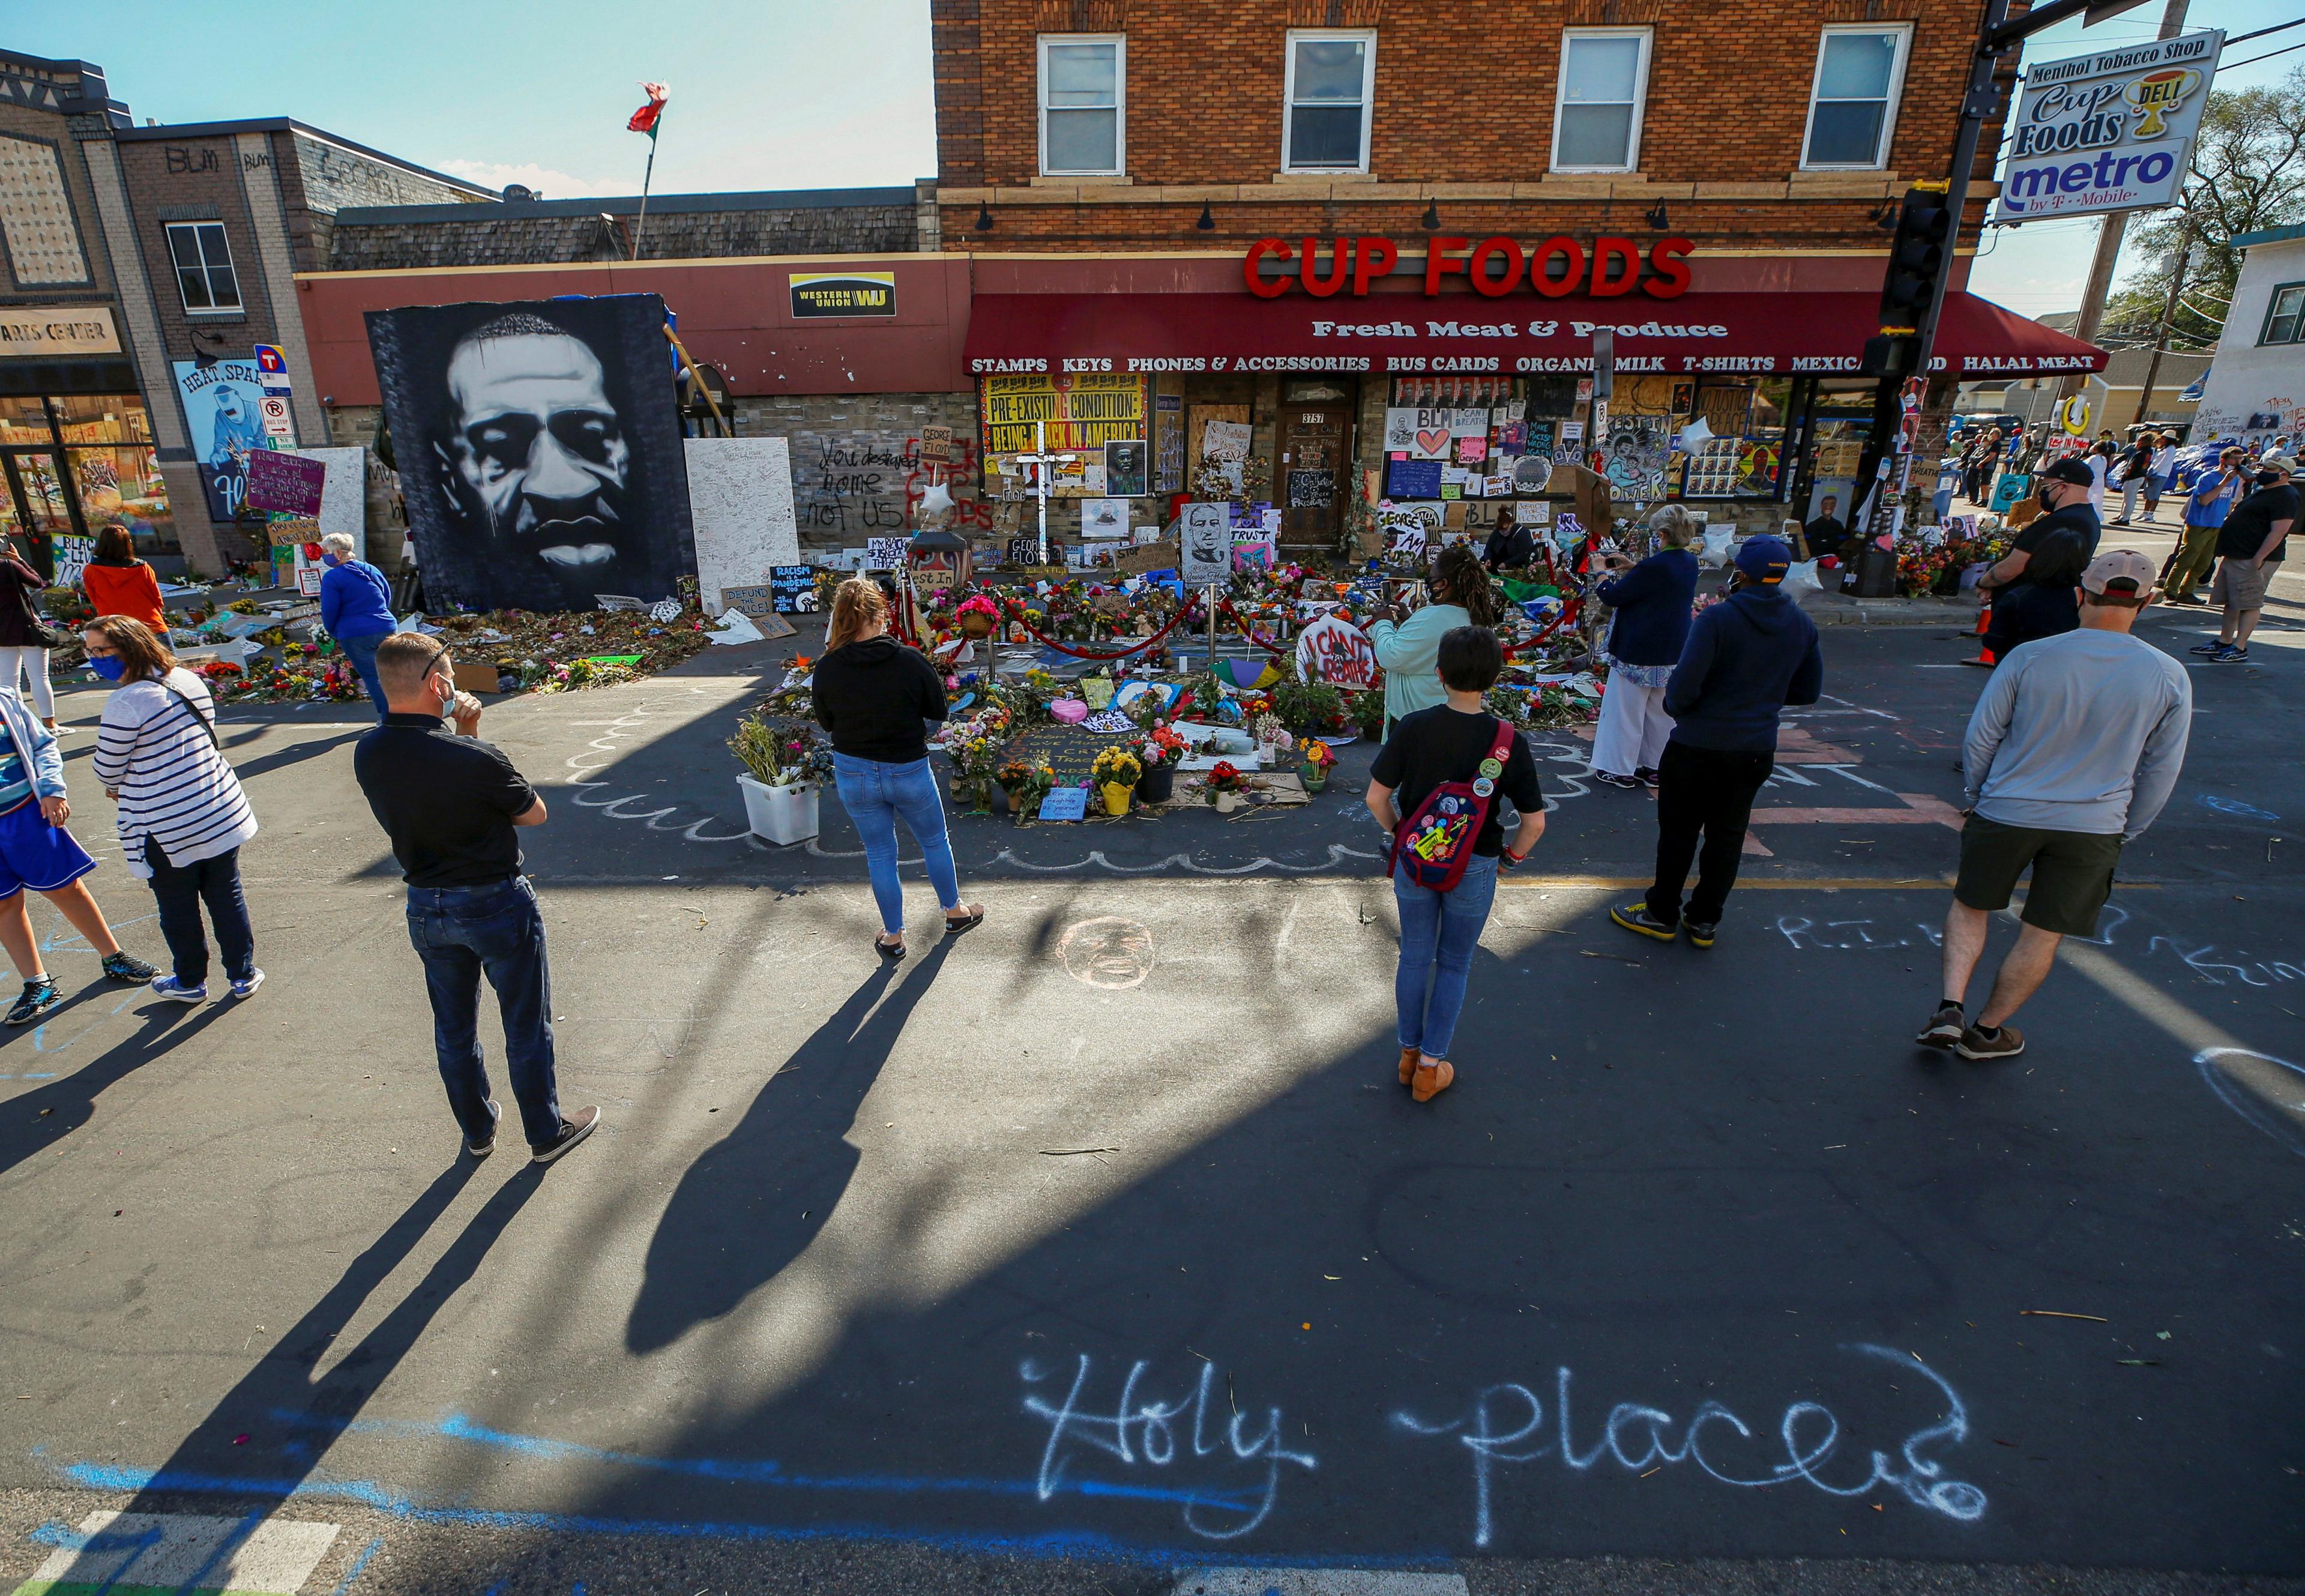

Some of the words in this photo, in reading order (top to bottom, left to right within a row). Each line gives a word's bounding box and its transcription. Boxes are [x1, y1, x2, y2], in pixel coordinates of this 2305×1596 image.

[2031, 58, 2090, 84] Menthol
[2096, 49, 2159, 72] Tobacco
[2164, 38, 2205, 60] Shop
[2138, 80, 2181, 106] DELI
[2031, 83, 2124, 122] Cup
[2013, 113, 2122, 156] Foods
[165, 146, 219, 174] BLM
[244, 153, 270, 172] BLM
[2008, 151, 2174, 200] metro
[2030, 199, 2047, 212] by
[1244, 236, 1398, 299] CUP
[1425, 236, 1696, 299] FOODS
[799, 291, 851, 300] WESTERN
[855, 289, 886, 307] WU
[1, 324, 42, 342] ARTS
[46, 322, 107, 341] CENTER
[1312, 321, 1417, 337] Fresh
[1426, 321, 1519, 337] Meat
[1528, 320, 1559, 337] &
[971, 358, 1047, 372] STAMPS
[1062, 358, 1113, 372] KEYS
[1127, 357, 1205, 372] PHONES
[1211, 357, 1228, 371] &
[1233, 357, 1370, 371] ACCESSORIES
[1387, 357, 1426, 371] BUS
[1431, 357, 1499, 371] CARDS
[1516, 357, 1594, 371] ORGANI
[1614, 357, 1665, 371] MILK
[1683, 357, 1776, 371] T-SHIRTS
[1791, 356, 1862, 370] MEXIC
[1963, 357, 2034, 370] HALAL
[2037, 355, 2094, 370] MEAT
[182, 366, 225, 394] HEAT,
[990, 394, 1068, 422] PRE-EXISTING
[1071, 393, 1137, 419] CONDITION:
[1712, 390, 1749, 412] JUSTICE
[1303, 414, 1324, 423] 3757
[1417, 409, 1453, 429] BLM
[1455, 409, 1460, 418] I
[1464, 409, 1486, 418] CANT
[1210, 423, 1220, 433] No
[1321, 423, 1343, 435] Child
[1455, 418, 1487, 427] BREATHE
[1531, 422, 1549, 432] MAKE
[1649, 416, 1674, 442] IN
[1711, 411, 1746, 436] PEACE
[923, 429, 950, 442] GEORGE
[992, 425, 1027, 452] BEING
[1031, 423, 1066, 450] BACK
[1070, 423, 1082, 449] IN
[1529, 432, 1553, 441] RACISM
[925, 444, 950, 456] FLOYD
[1528, 440, 1552, 449] WRONG
[819, 438, 858, 469] You
[1459, 453, 1481, 462] George
[368, 465, 394, 490] MY
[824, 468, 883, 496] home
[1004, 489, 1026, 501] FLOYD
[807, 493, 853, 531] not
[863, 501, 903, 528] US
[1517, 514, 1547, 522] FLOYD
[1560, 514, 1572, 524] NO
[885, 537, 908, 550] BLACK
[1231, 531, 1271, 541] TRUST
[1117, 547, 1140, 559] STOP
[776, 566, 810, 576] RACISM
[936, 572, 953, 584] In
[1186, 572, 1206, 580] George
[1207, 571, 1231, 580] Floyd
[772, 577, 815, 588] PANDEMIC
[726, 588, 769, 600] DEFUND
[1082, 708, 1118, 724] BLACK
[1019, 1352, 1319, 1541] Holy
